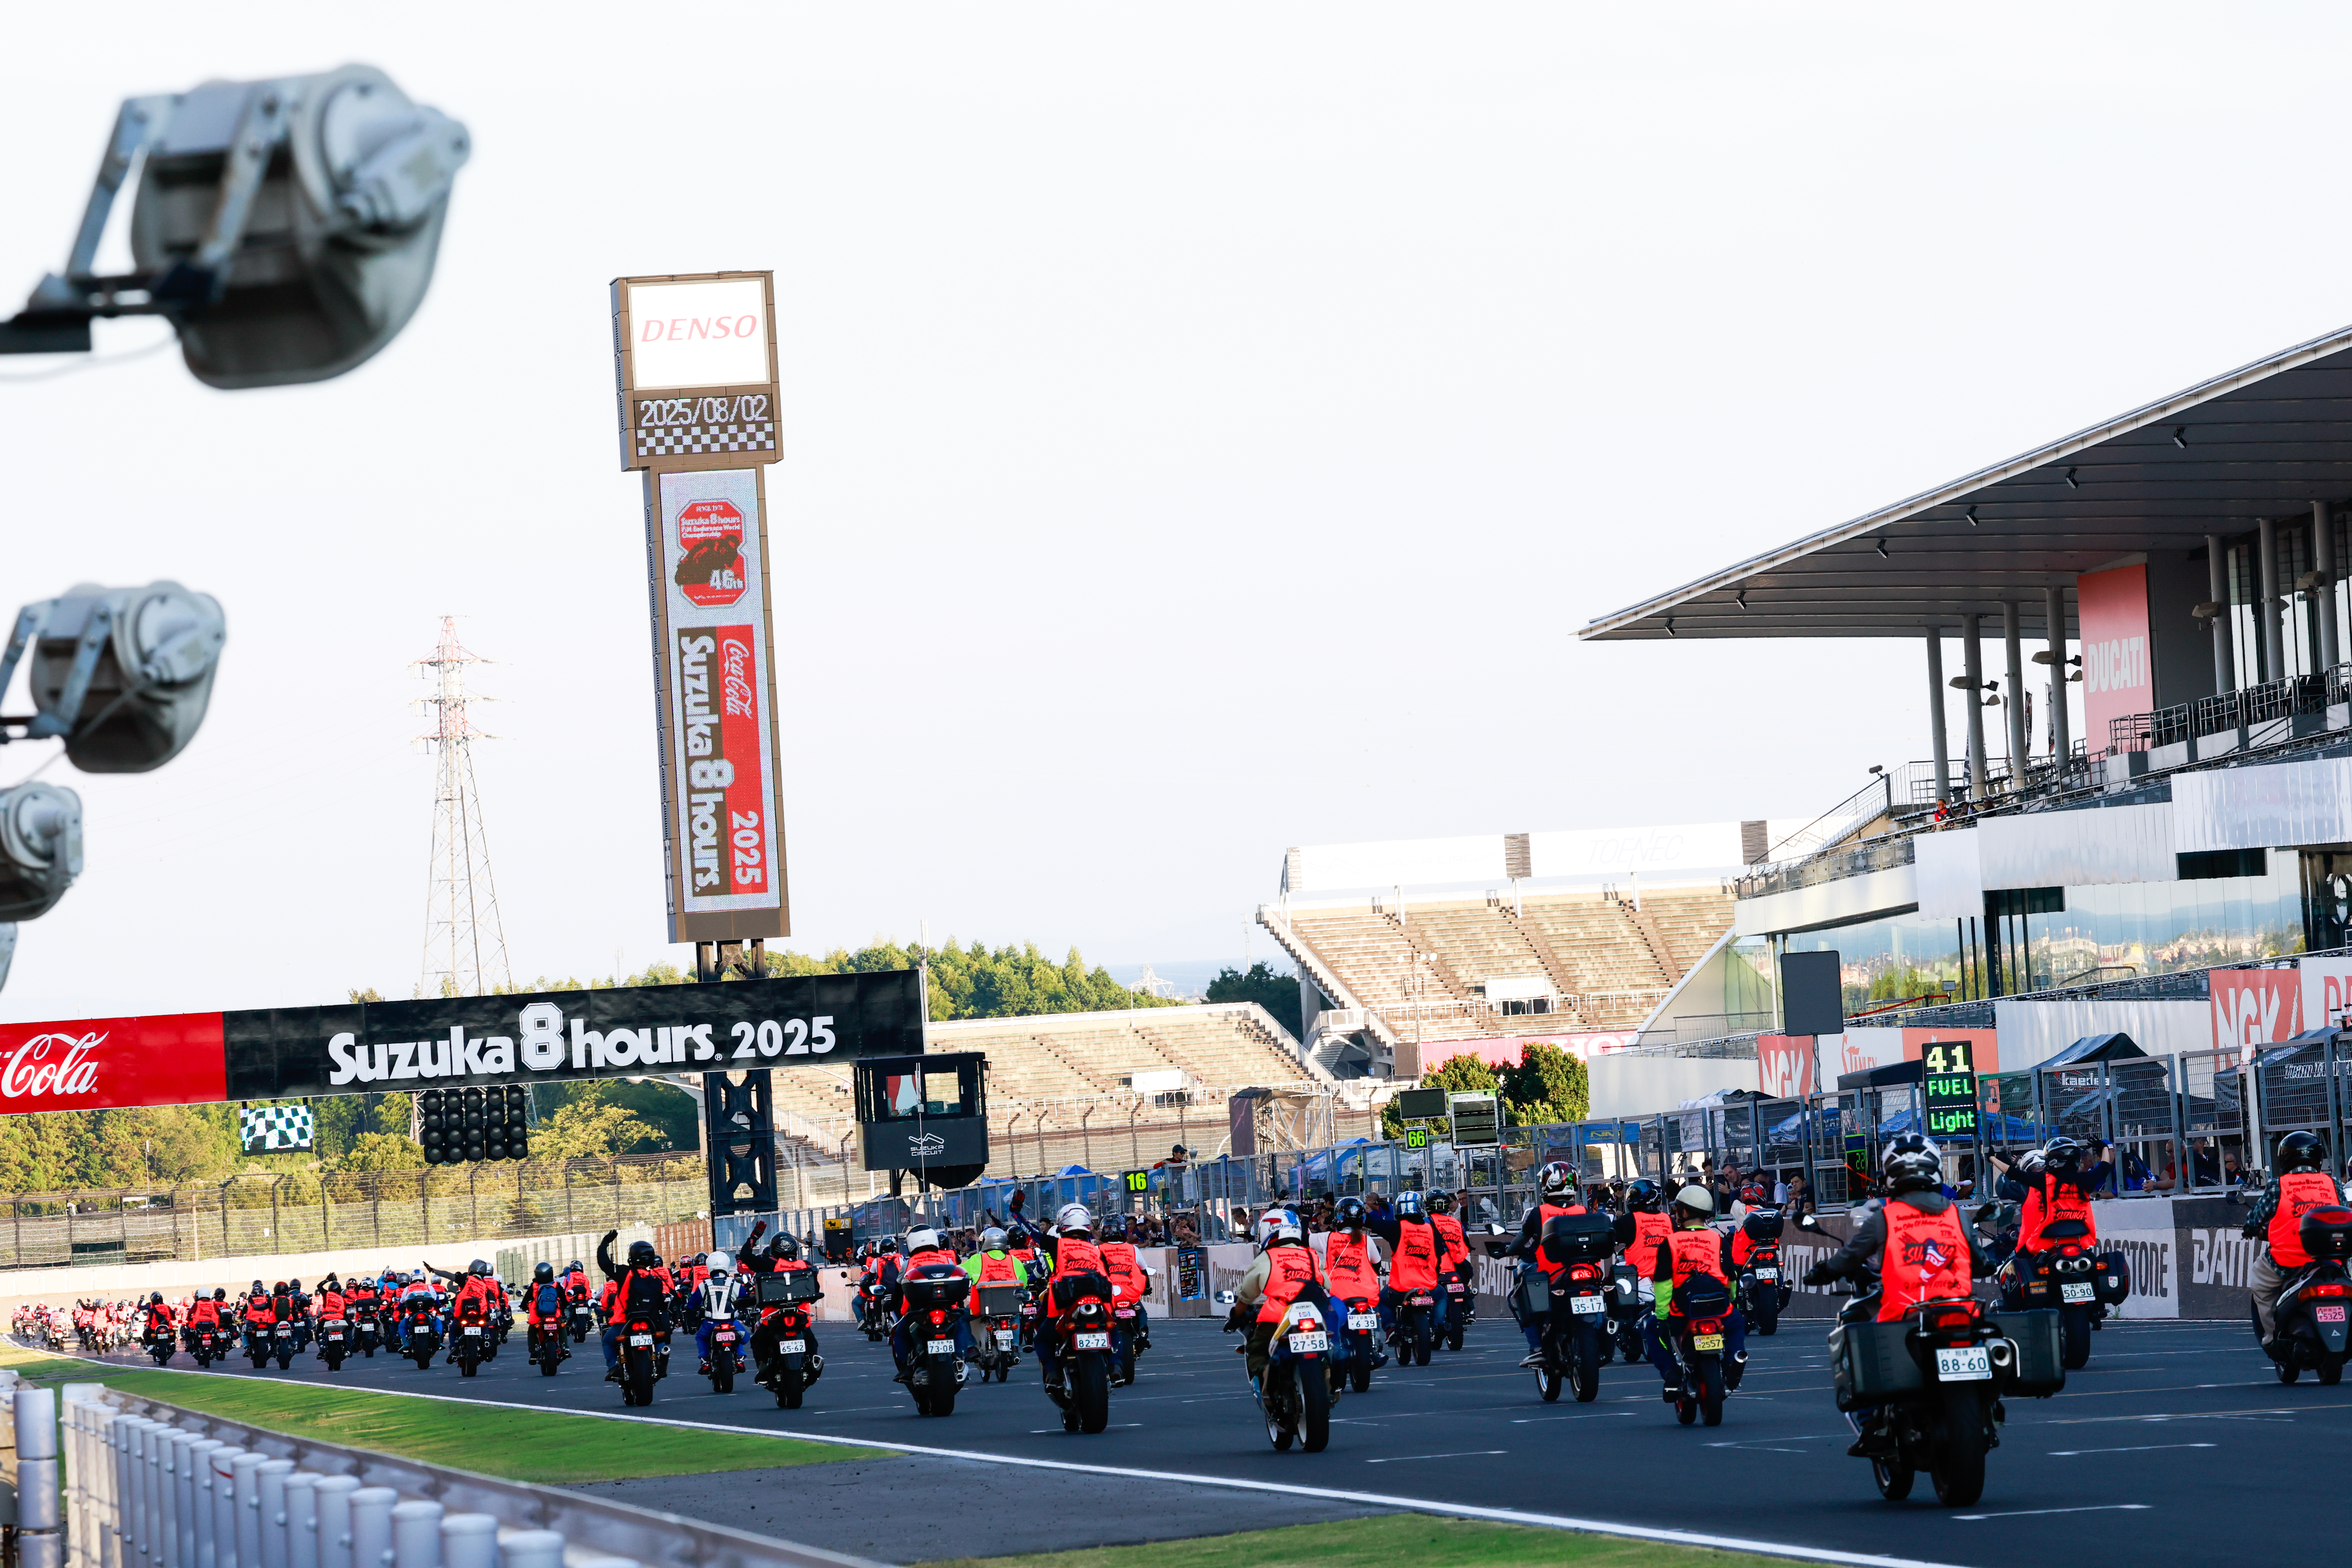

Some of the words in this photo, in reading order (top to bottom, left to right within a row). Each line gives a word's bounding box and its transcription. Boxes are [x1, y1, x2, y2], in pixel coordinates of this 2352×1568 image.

[641, 315, 757, 342] DENSO
[640, 394, 768, 427] 2025/08/02
[2088, 636, 2144, 693] DUCATI
[681, 635, 719, 757] Suzuka
[690, 758, 734, 789] 8
[732, 810, 762, 885] 2025
[2215, 983, 2280, 1054] NGK
[329, 1026, 514, 1085] Suzuka
[520, 1002, 564, 1071] 8
[731, 1016, 836, 1059] 2025
[1927, 1045, 1970, 1073] 41
[1761, 1047, 1805, 1098] NGK
[1929, 1078, 1973, 1096] FUEL
[1931, 1111, 1975, 1132] Light
[1408, 1130, 1425, 1147] 66
[1856, 1152, 1865, 1170] 22
[1126, 1173, 1147, 1191] 16
[840, 1219, 849, 1229] 29
[2056, 1210, 2085, 1220] SUZUKA
[2064, 1288, 2092, 1297] 50-90
[1574, 1302, 1601, 1312] 35-17
[929, 1345, 953, 1353] 73-08
[1079, 1339, 1106, 1347] 82-72
[1292, 1339, 1325, 1350] 27-58
[1701, 1339, 1720, 1348] 2557
[1942, 1357, 1986, 1372] 88-60
